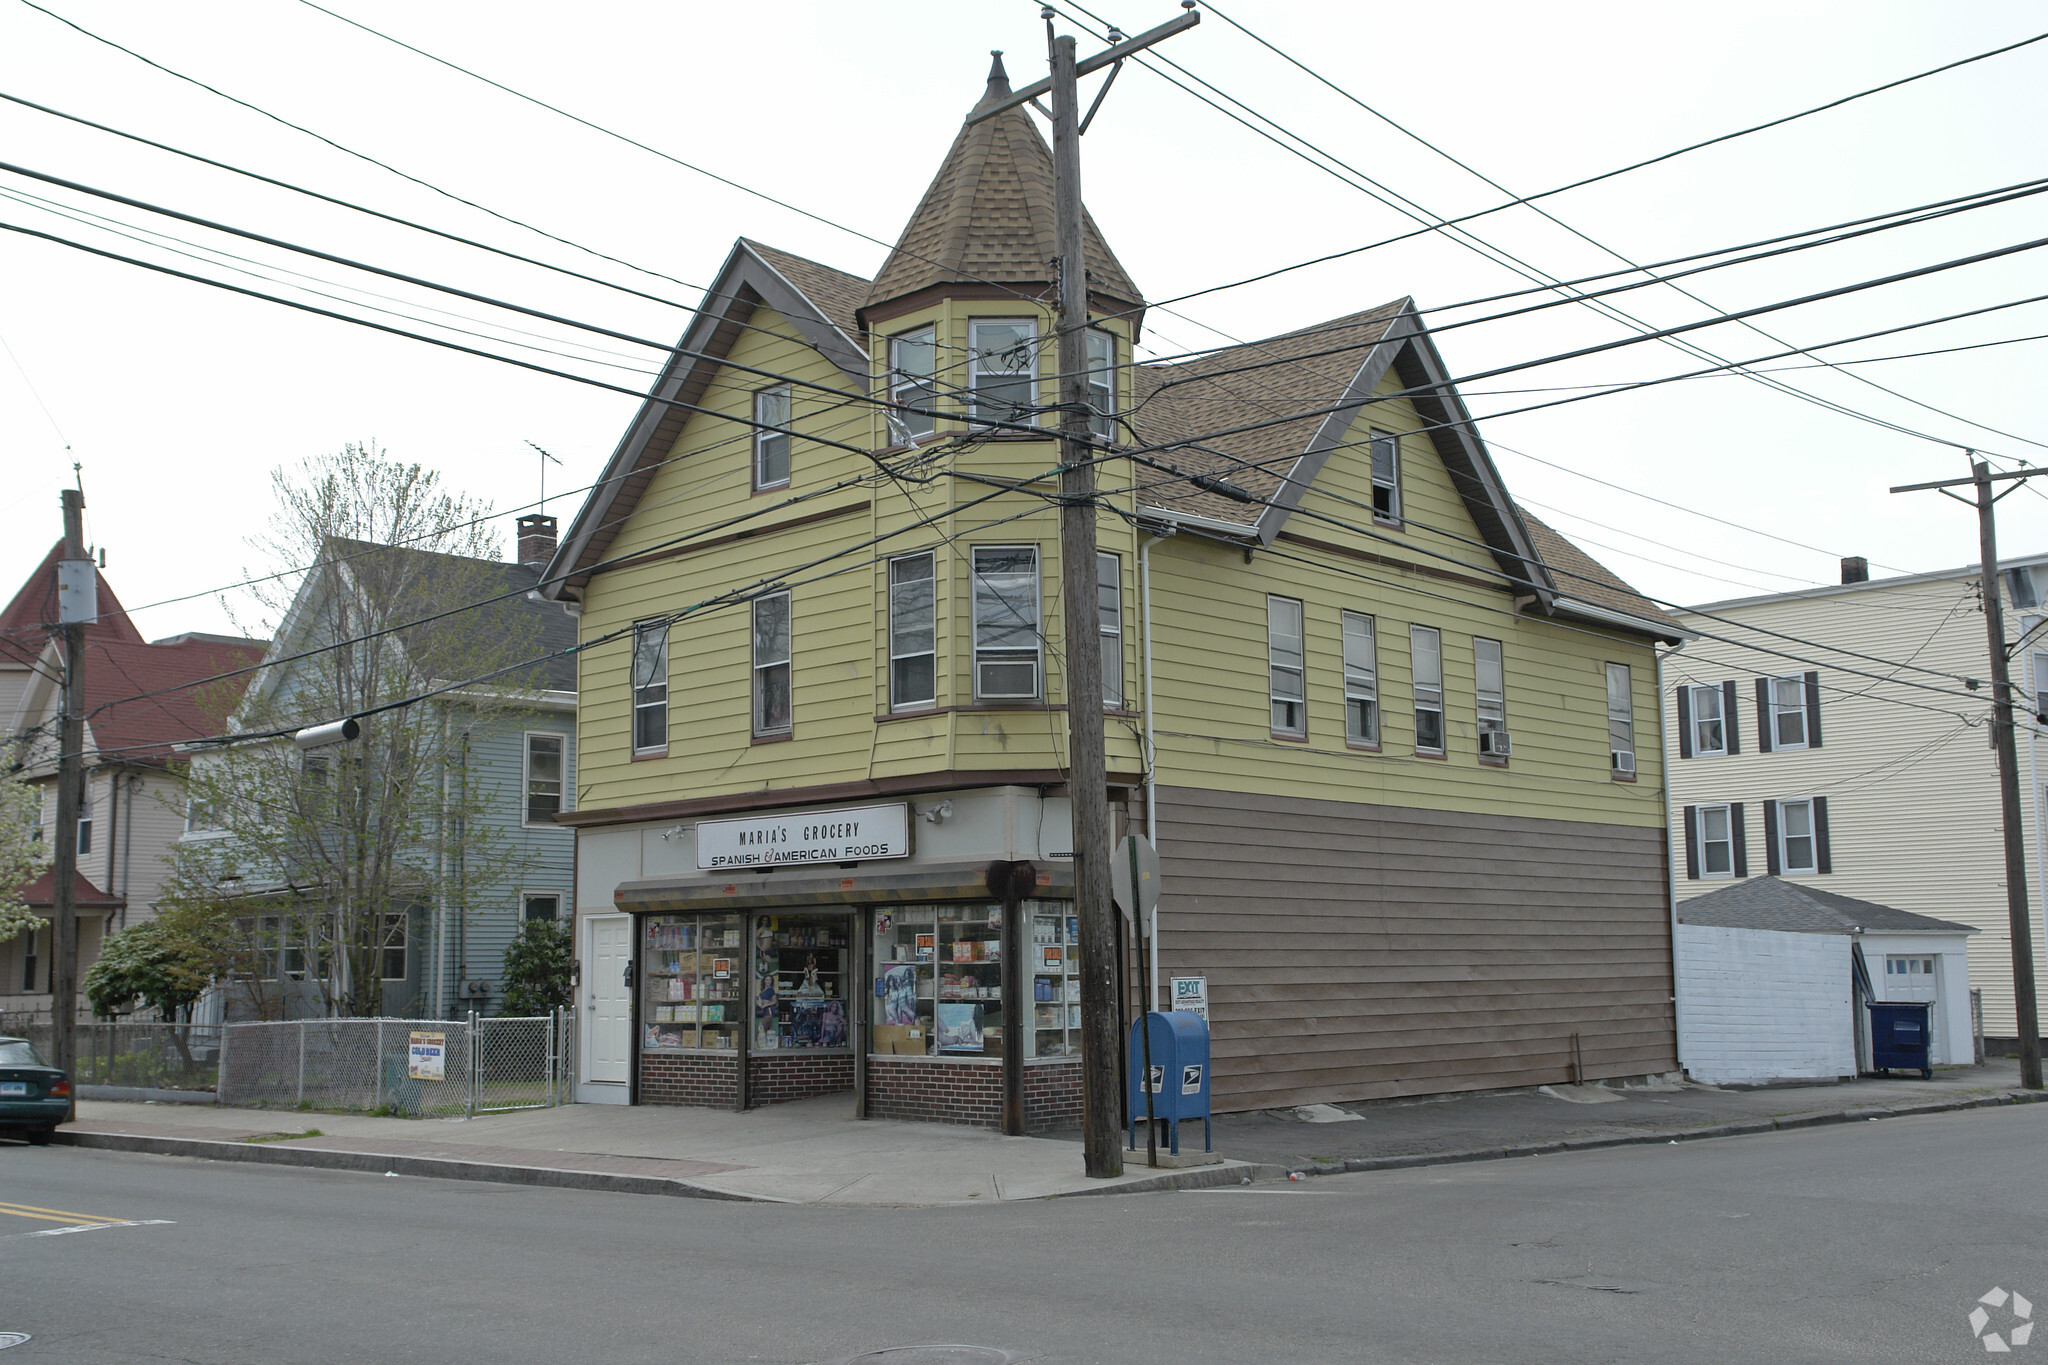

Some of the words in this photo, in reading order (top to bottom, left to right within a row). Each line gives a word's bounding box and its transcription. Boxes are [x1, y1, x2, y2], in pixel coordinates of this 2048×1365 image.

[739, 826, 787, 846] MARIA'S
[803, 822, 860, 841] GROCERY
[711, 853, 760, 866] SPANISH
[774, 847, 837, 862] AMERICAN
[845, 843, 889, 857] FOODS
[1177, 981, 1200, 995] EXIT
[412, 1047, 425, 1055] COLD
[426, 1047, 440, 1056] BEER
